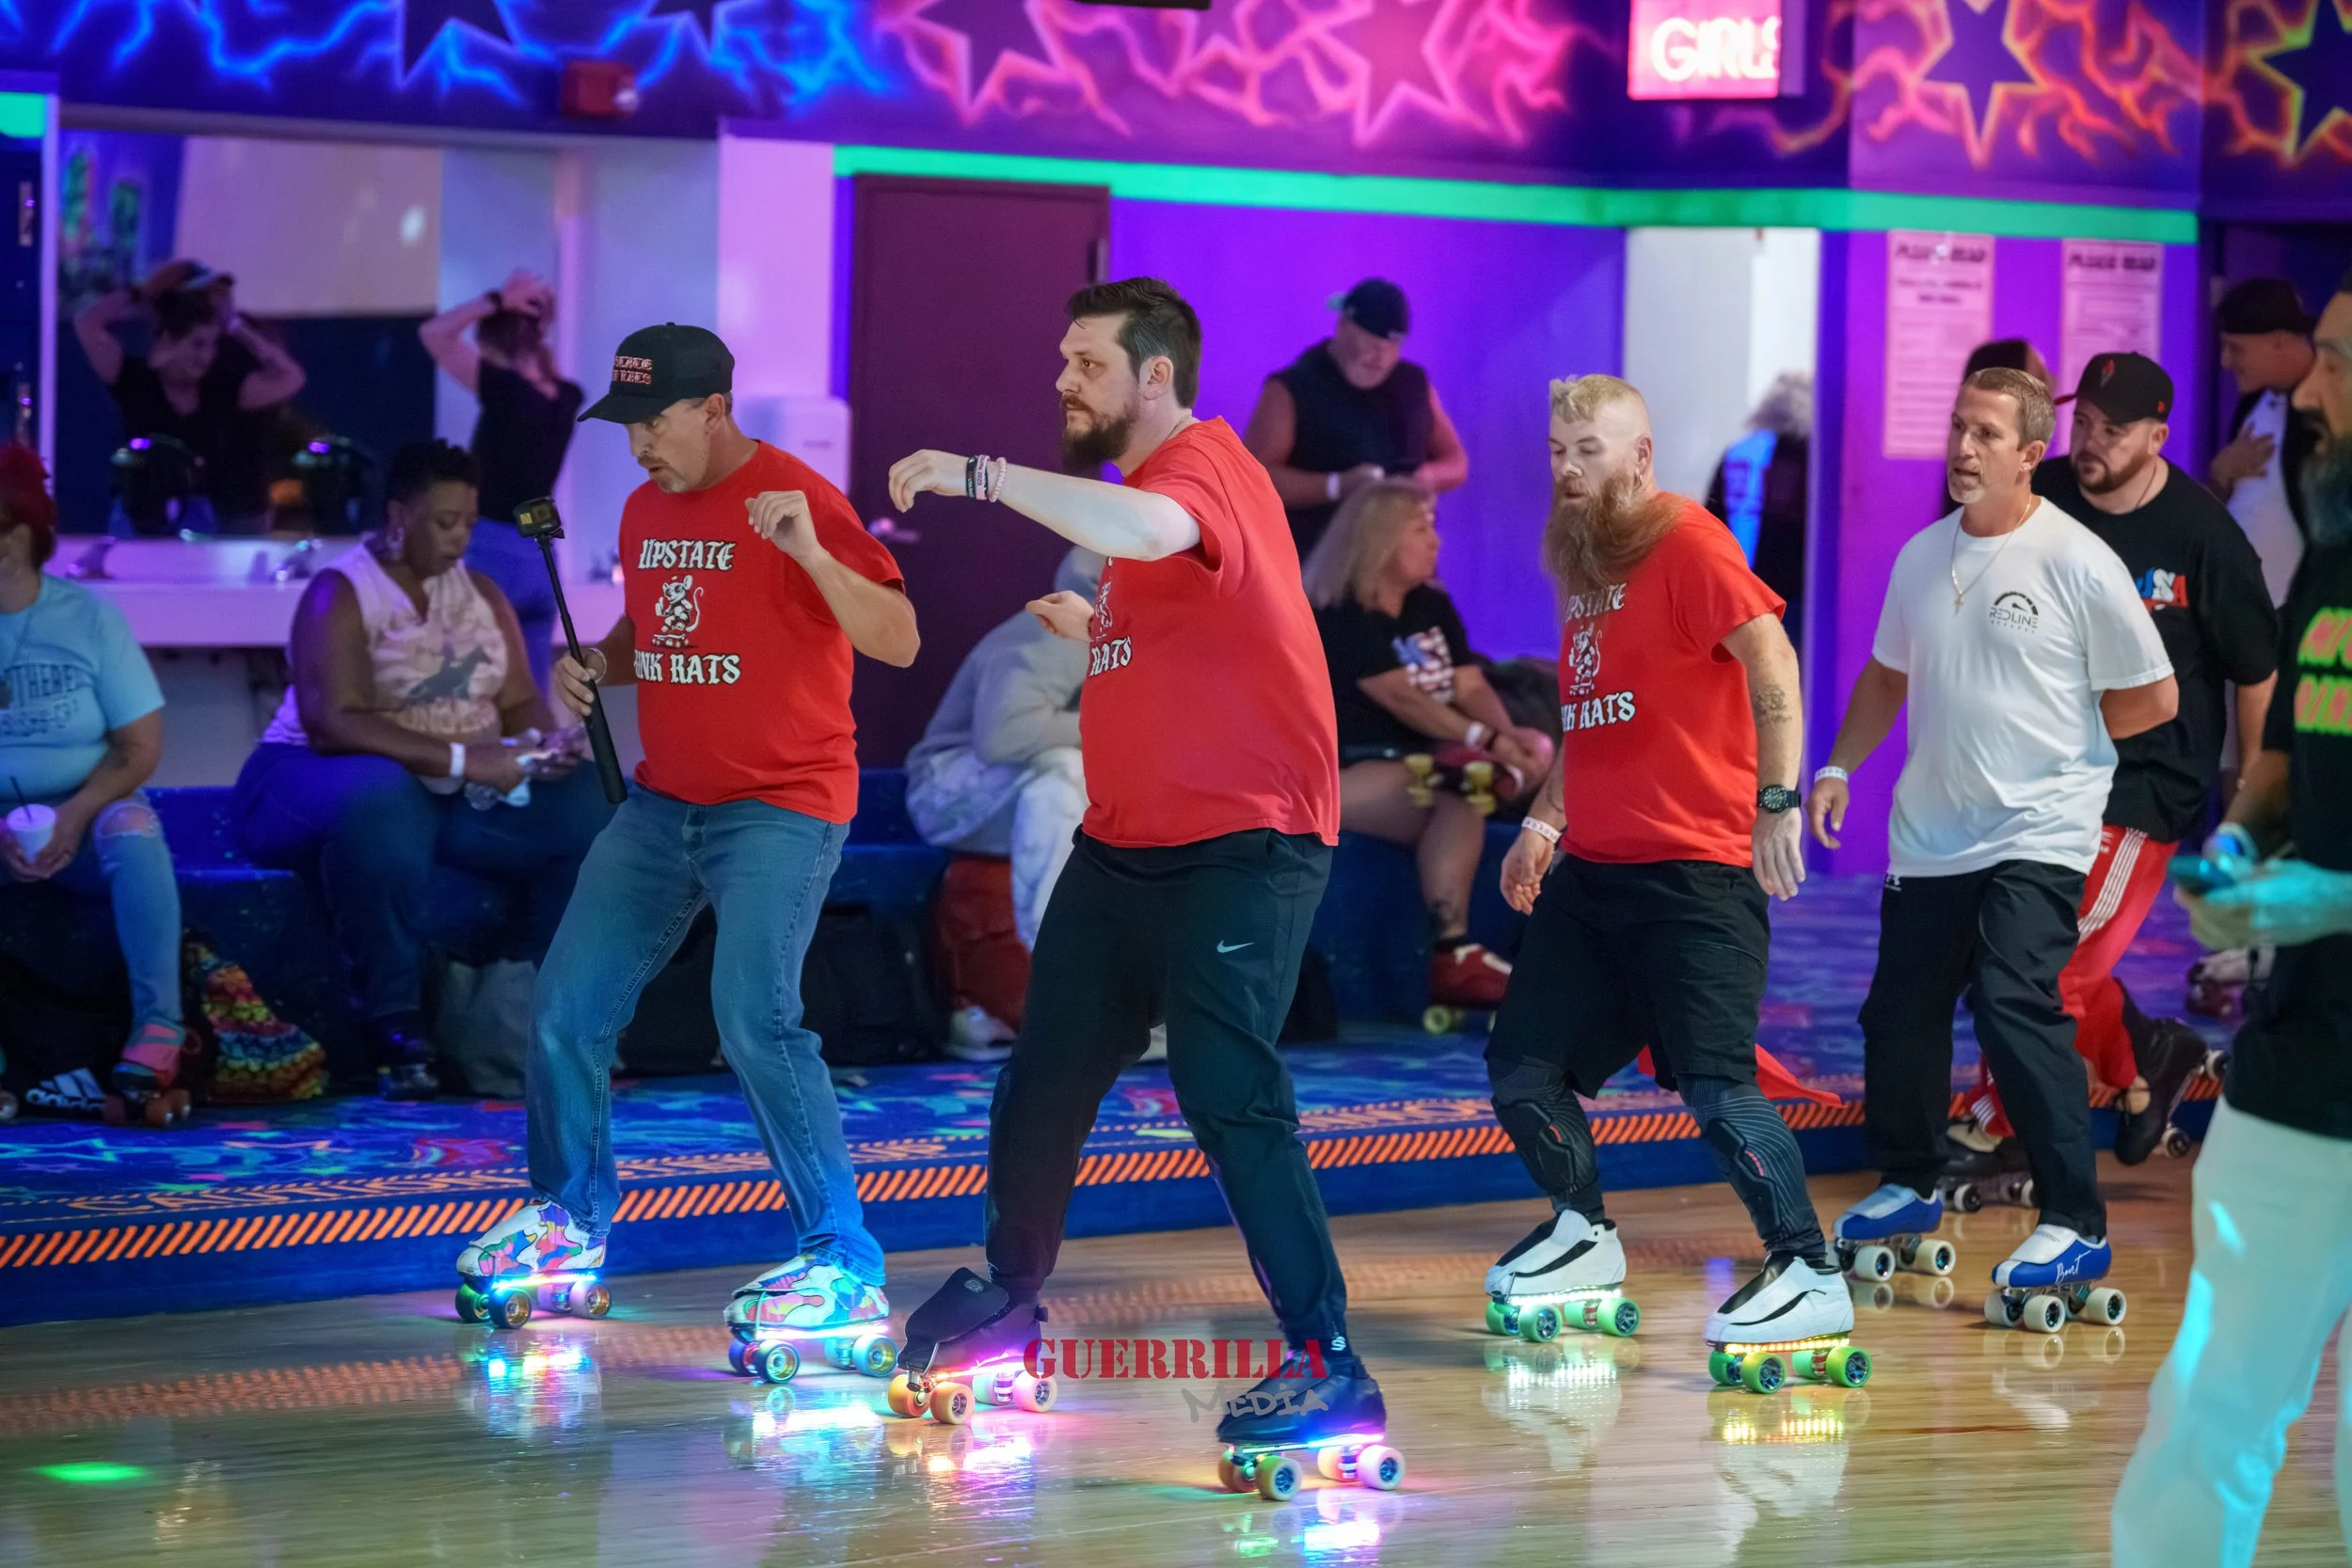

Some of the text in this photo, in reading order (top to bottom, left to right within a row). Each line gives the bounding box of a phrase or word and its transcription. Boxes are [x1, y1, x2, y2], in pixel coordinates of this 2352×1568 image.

[638, 538, 737, 571] UPSTATE
[1989, 607, 2039, 629] REDLINE
[669, 653, 742, 686] RATS
[1089, 635, 1132, 677] RATS
[1579, 690, 1636, 730] RATS
